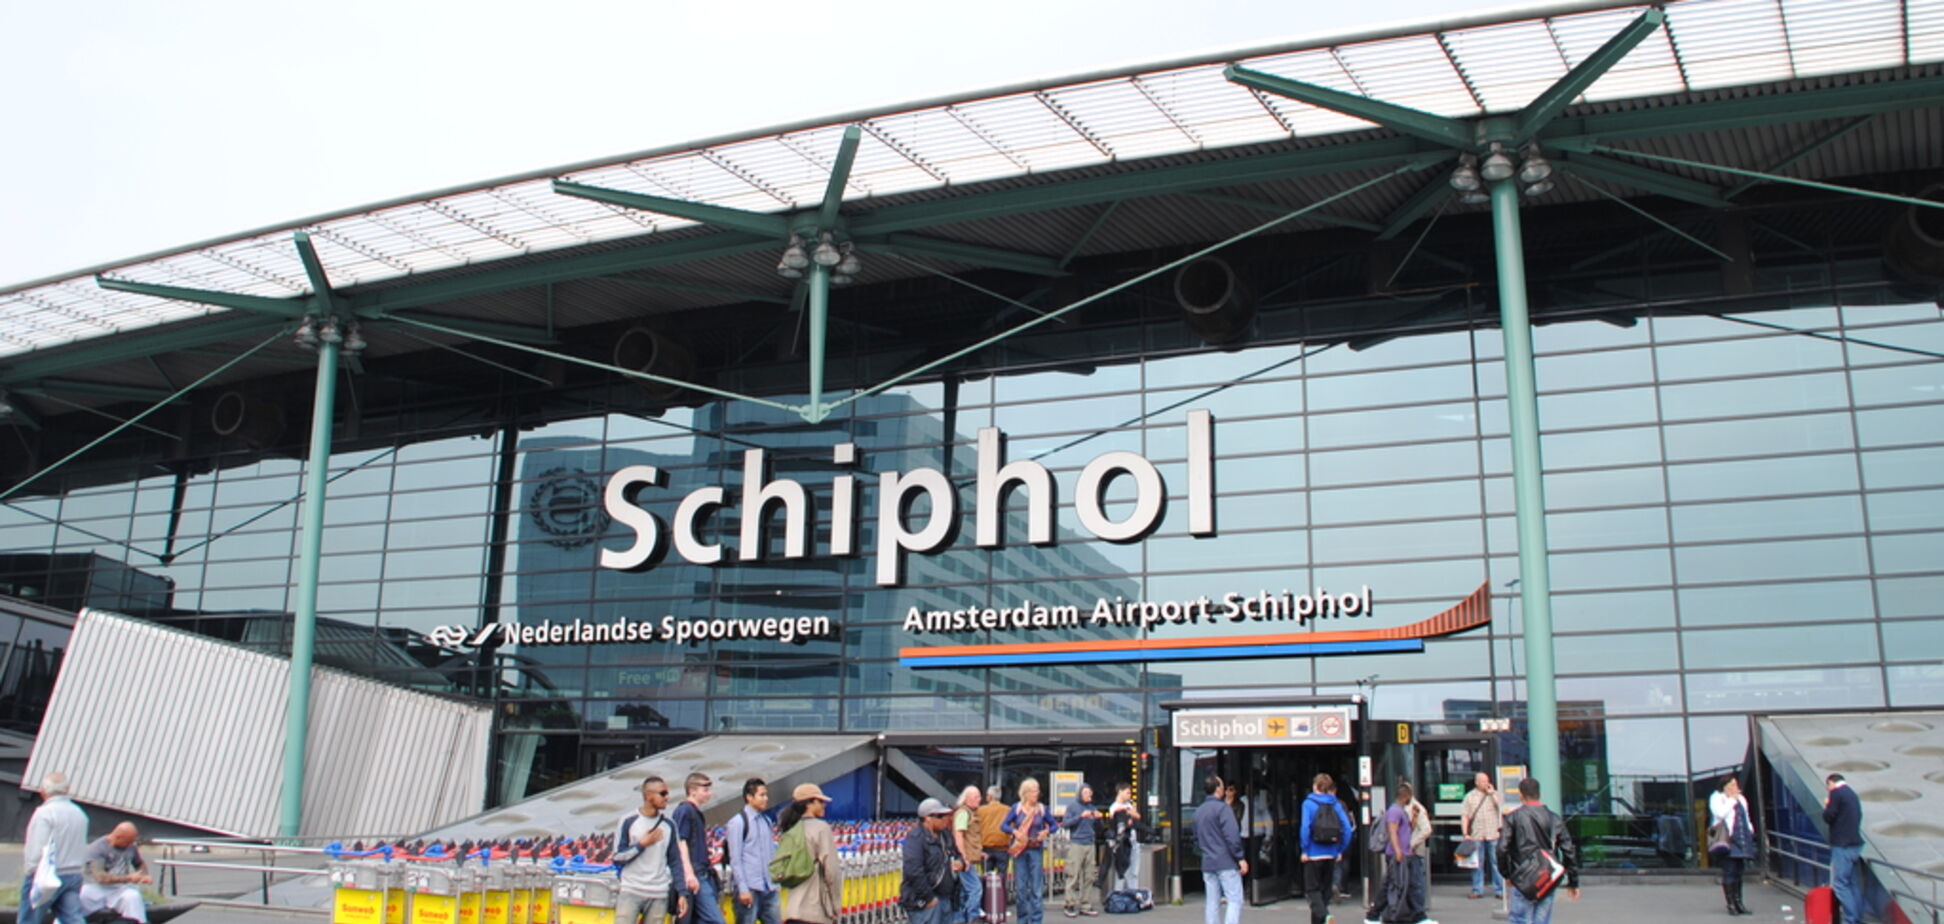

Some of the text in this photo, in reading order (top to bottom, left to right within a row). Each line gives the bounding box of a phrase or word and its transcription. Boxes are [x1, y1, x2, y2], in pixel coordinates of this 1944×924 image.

[600, 408, 1215, 586] Schiphol
[903, 584, 1372, 632] Amsterdam Airport Schiphol
[504, 614, 830, 645] Nederlandse Spoorwegen
[618, 671, 651, 685] Free
[1179, 717, 1263, 740] Schiphol
